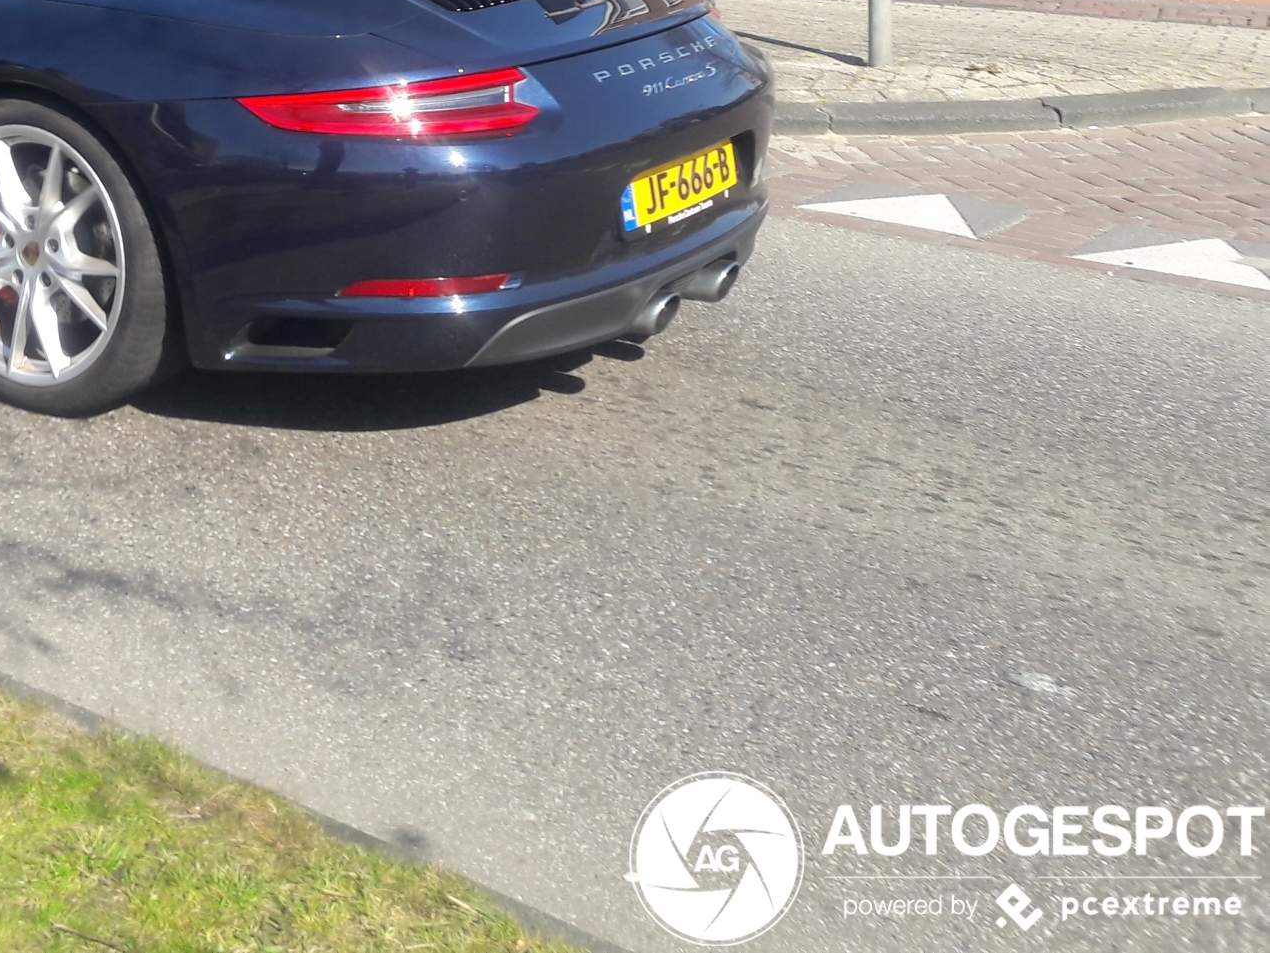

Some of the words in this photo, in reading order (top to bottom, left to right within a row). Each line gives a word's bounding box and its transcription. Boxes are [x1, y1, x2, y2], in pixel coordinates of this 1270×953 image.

[593, 36, 717, 83] PORSCHE
[642, 82, 664, 97] 911
[705, 62, 717, 78] S
[646, 148, 730, 215] JF-666-B
[623, 209, 635, 222] NL
